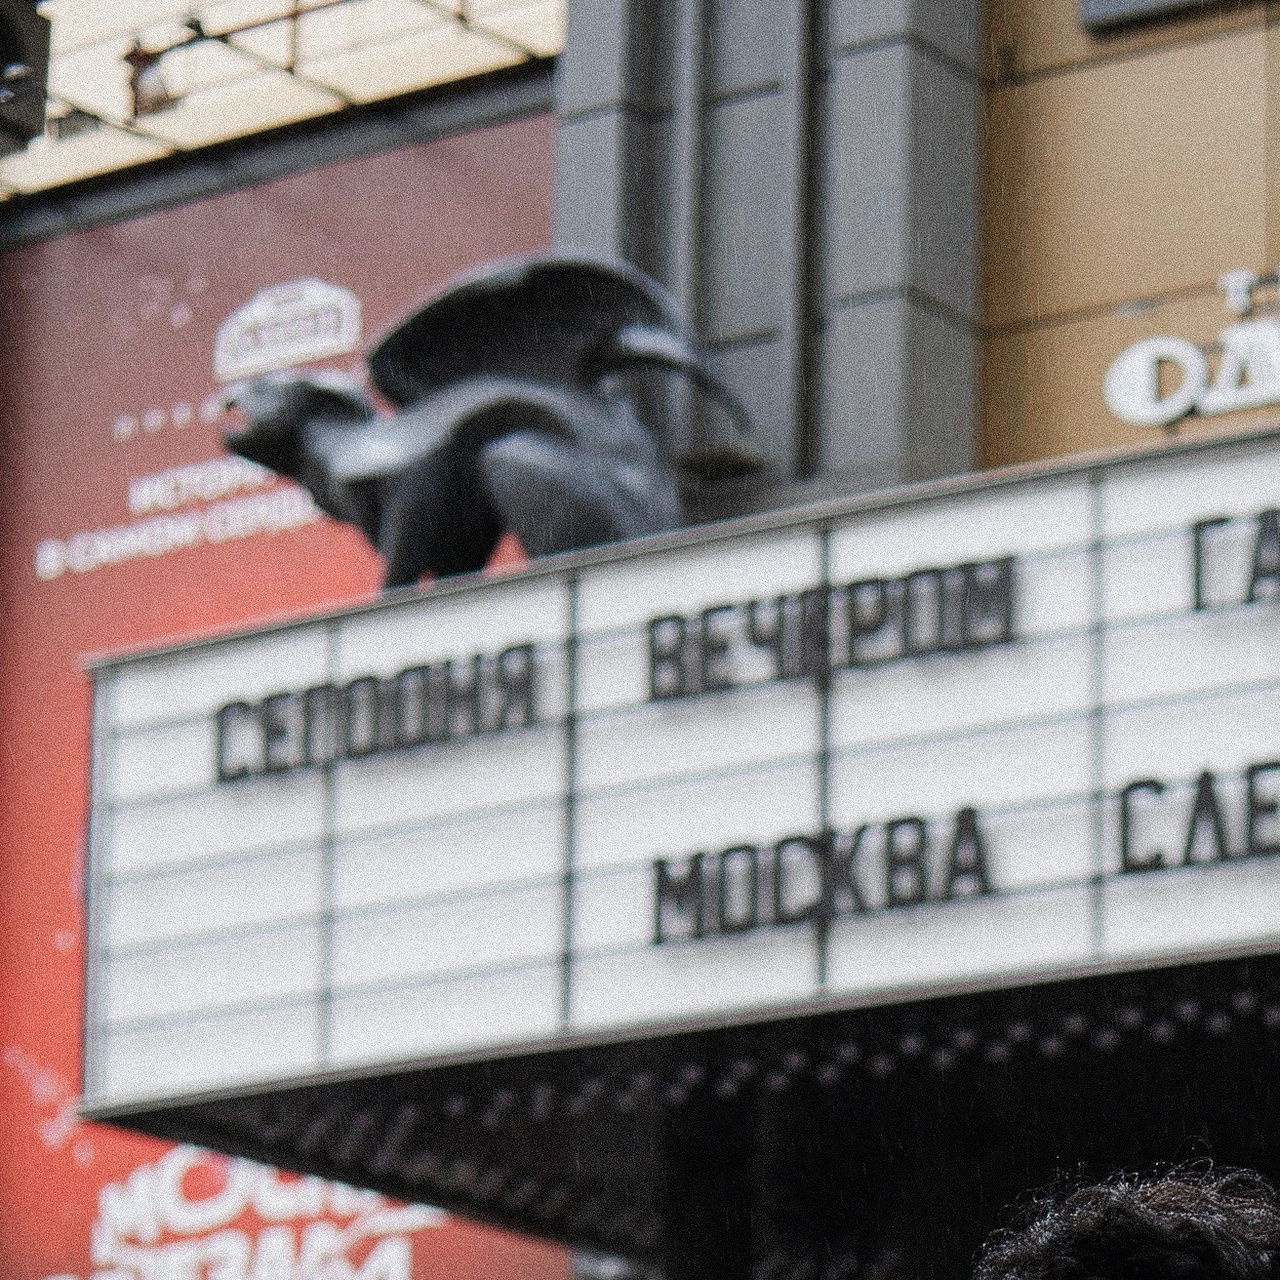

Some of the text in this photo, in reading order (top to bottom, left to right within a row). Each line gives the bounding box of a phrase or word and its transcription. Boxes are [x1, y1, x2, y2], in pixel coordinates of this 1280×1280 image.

[216, 642, 534, 783] СЕГОДНЯ
[646, 553, 1017, 701] ВЕЧЕРОМ
[653, 806, 995, 946] МОСКВА
